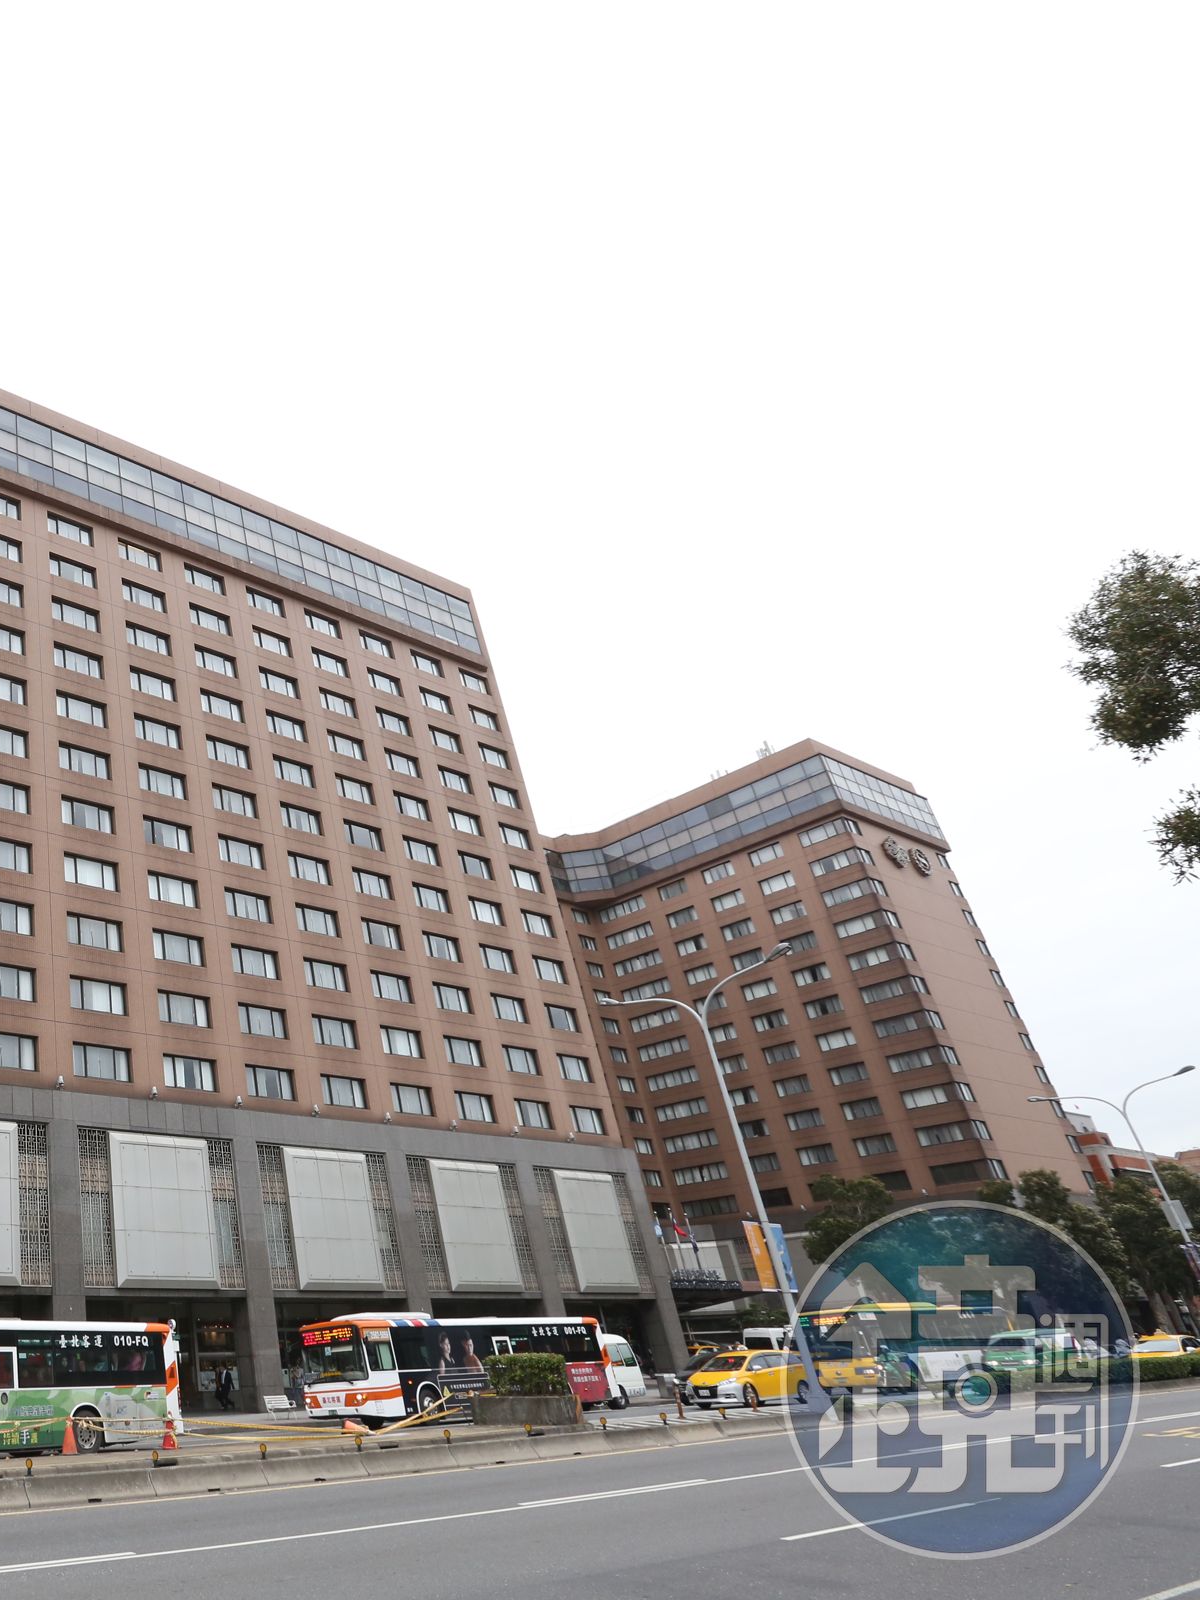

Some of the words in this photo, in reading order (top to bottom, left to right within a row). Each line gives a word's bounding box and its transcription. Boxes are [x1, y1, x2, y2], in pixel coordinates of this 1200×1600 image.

[59, 1335, 104, 1348] 臺北客運
[113, 1335, 150, 1347] 010-FQ
